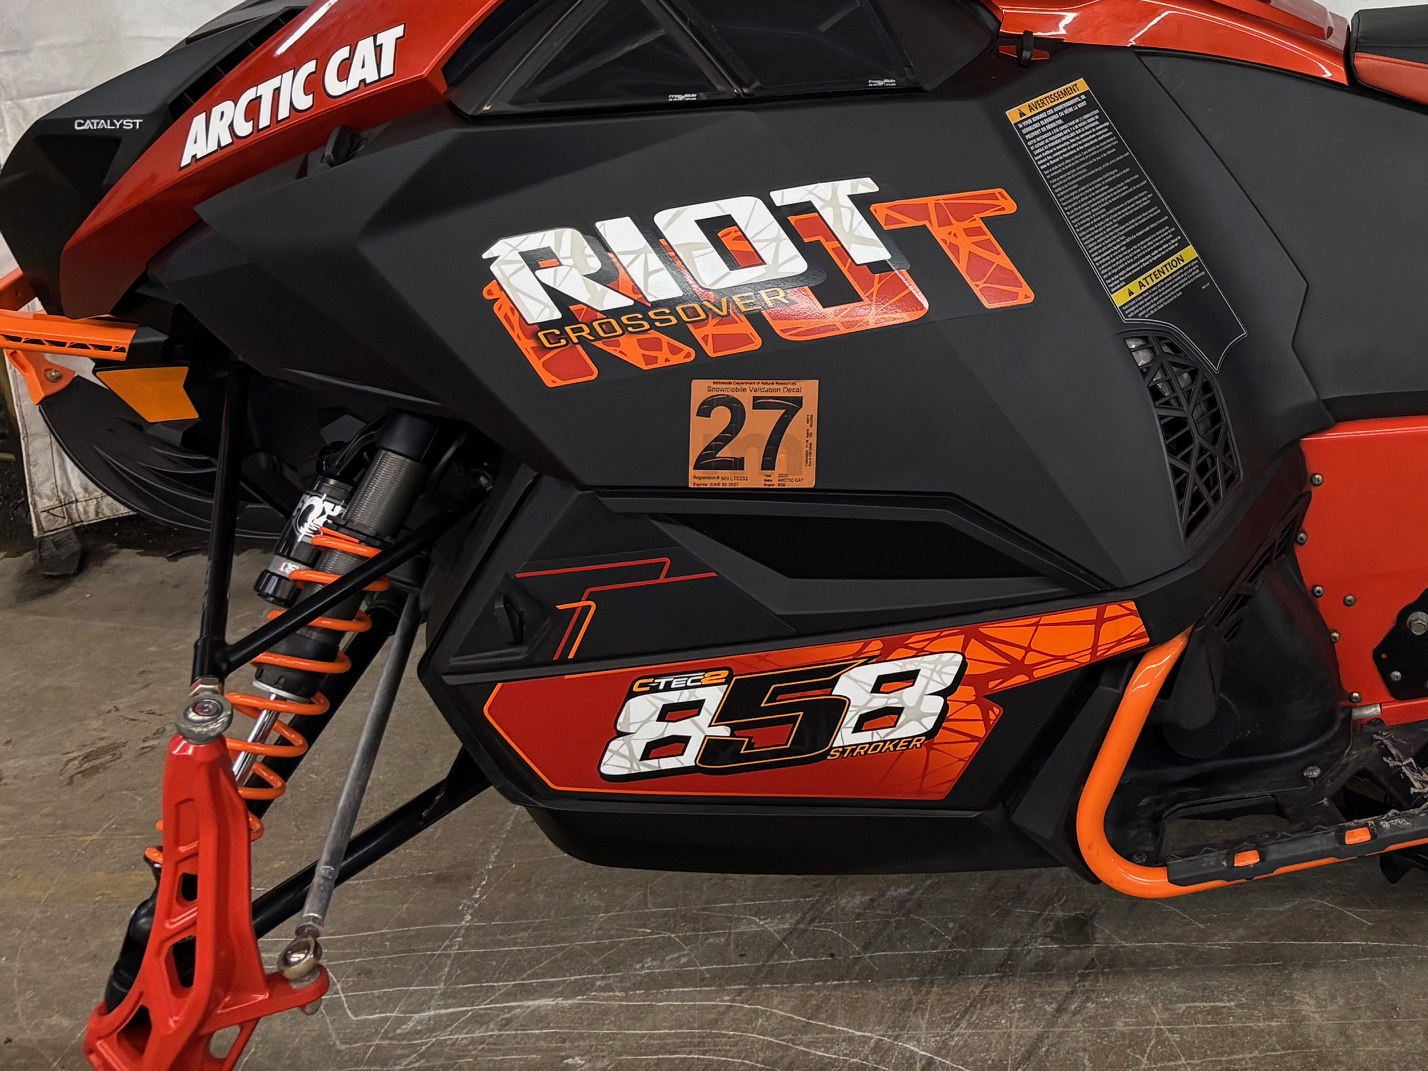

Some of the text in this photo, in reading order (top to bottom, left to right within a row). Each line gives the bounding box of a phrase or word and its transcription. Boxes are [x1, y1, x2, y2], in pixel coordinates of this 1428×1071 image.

[179, 23, 406, 171] ARCTIC CAT
[1027, 83, 1081, 114] AVERTISSEMENT
[74, 118, 143, 130] CATALYST
[481, 176, 892, 325] RIOT
[1137, 254, 1186, 291] ATTENTION
[537, 286, 791, 349] CROSSOVER
[693, 394, 803, 471] 27
[632, 670, 729, 693] C-TEC2
[599, 652, 966, 779] 858
[826, 736, 926, 760] STROKER
